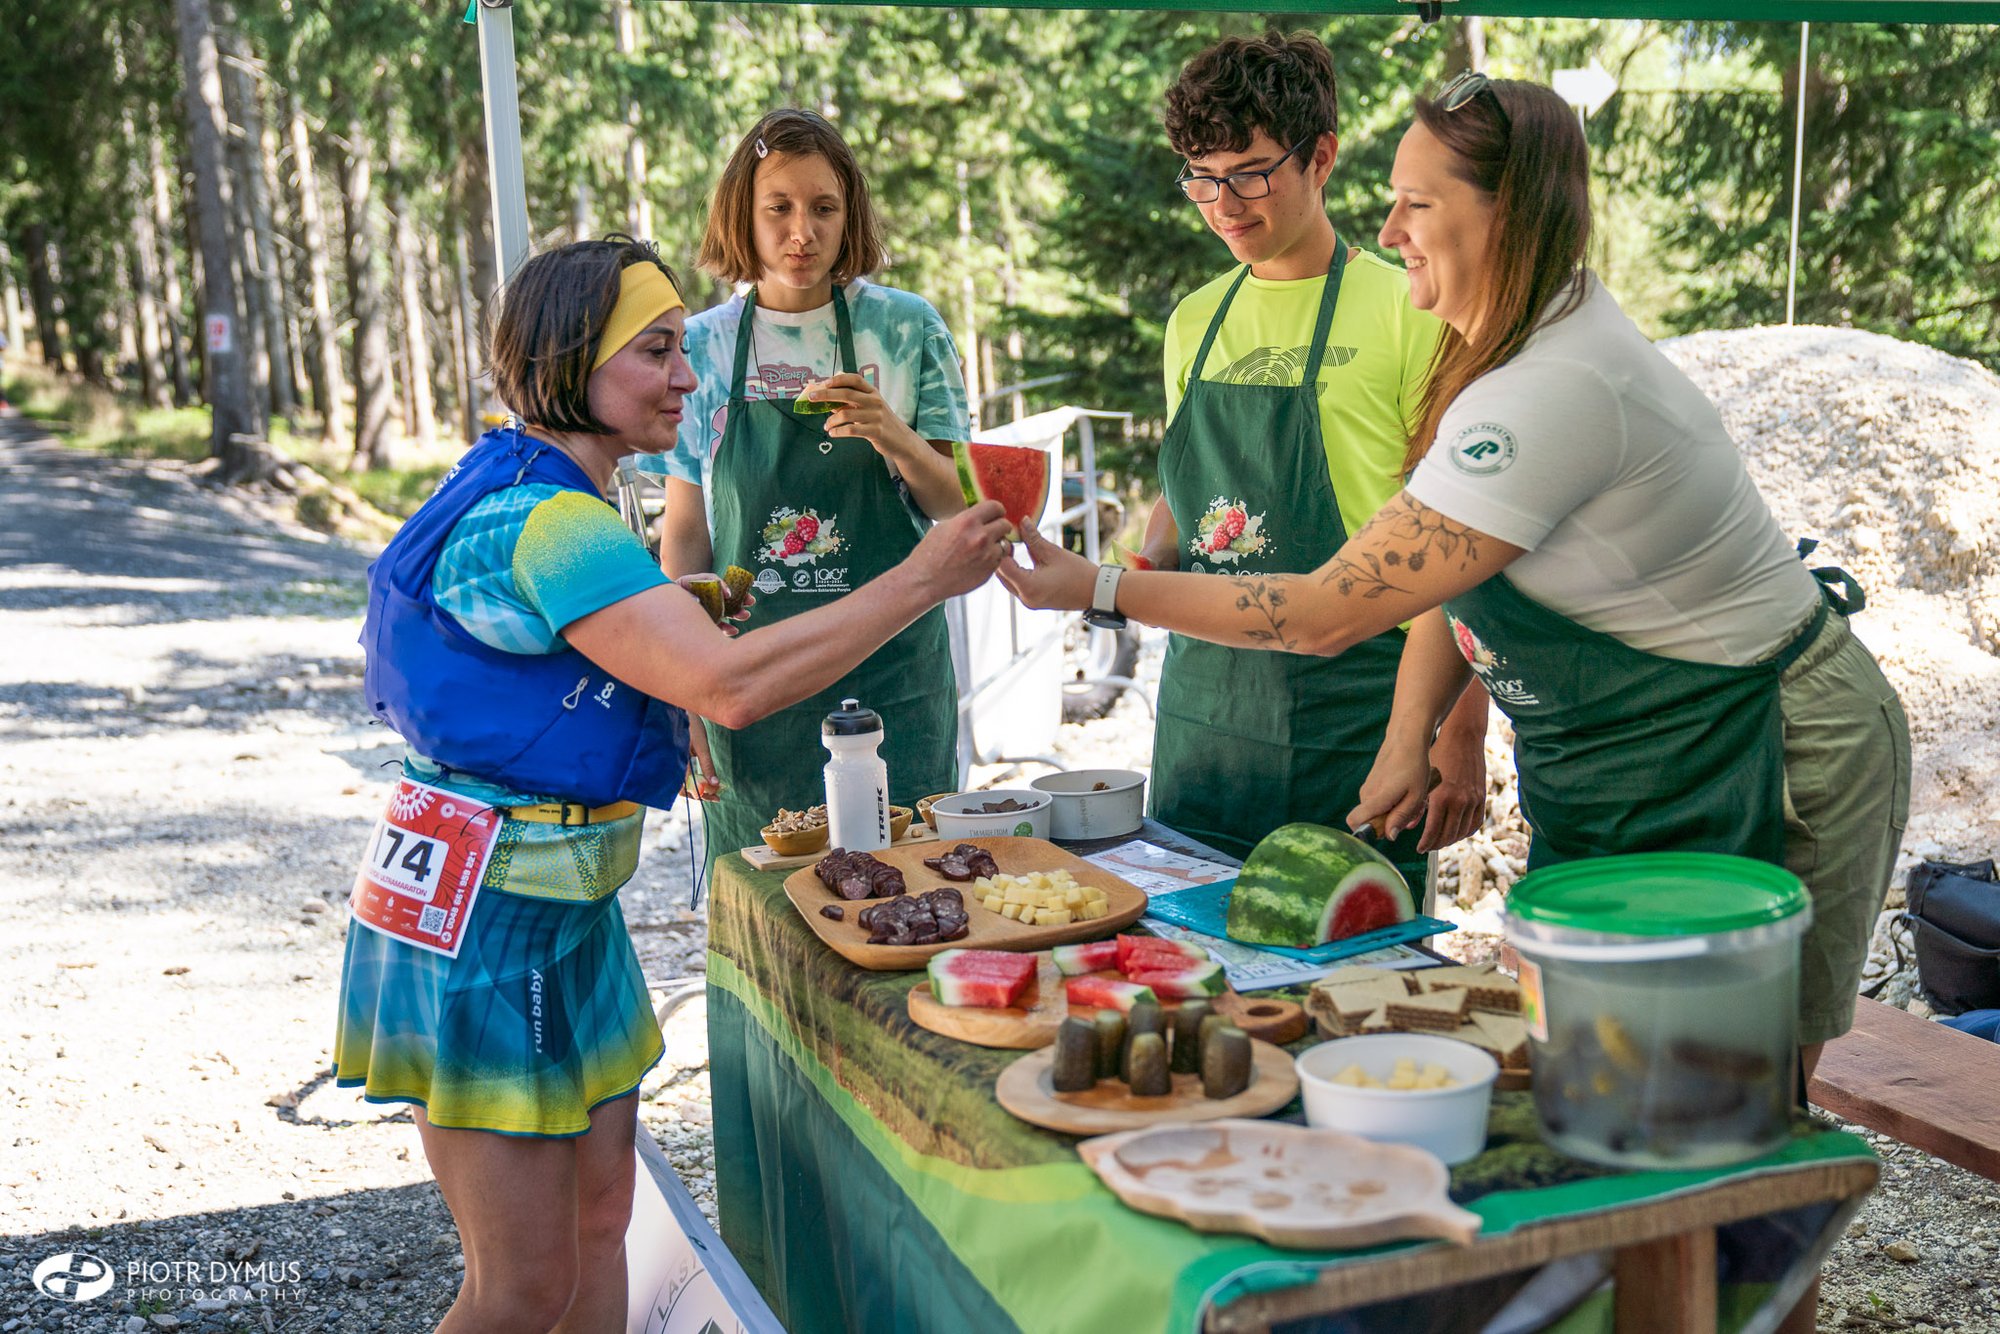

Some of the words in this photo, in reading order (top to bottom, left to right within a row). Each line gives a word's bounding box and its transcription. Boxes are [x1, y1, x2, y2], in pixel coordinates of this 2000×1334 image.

[877, 786, 886, 844] TREK
[531, 968, 543, 1018] baby
[534, 1020, 542, 1054] run
